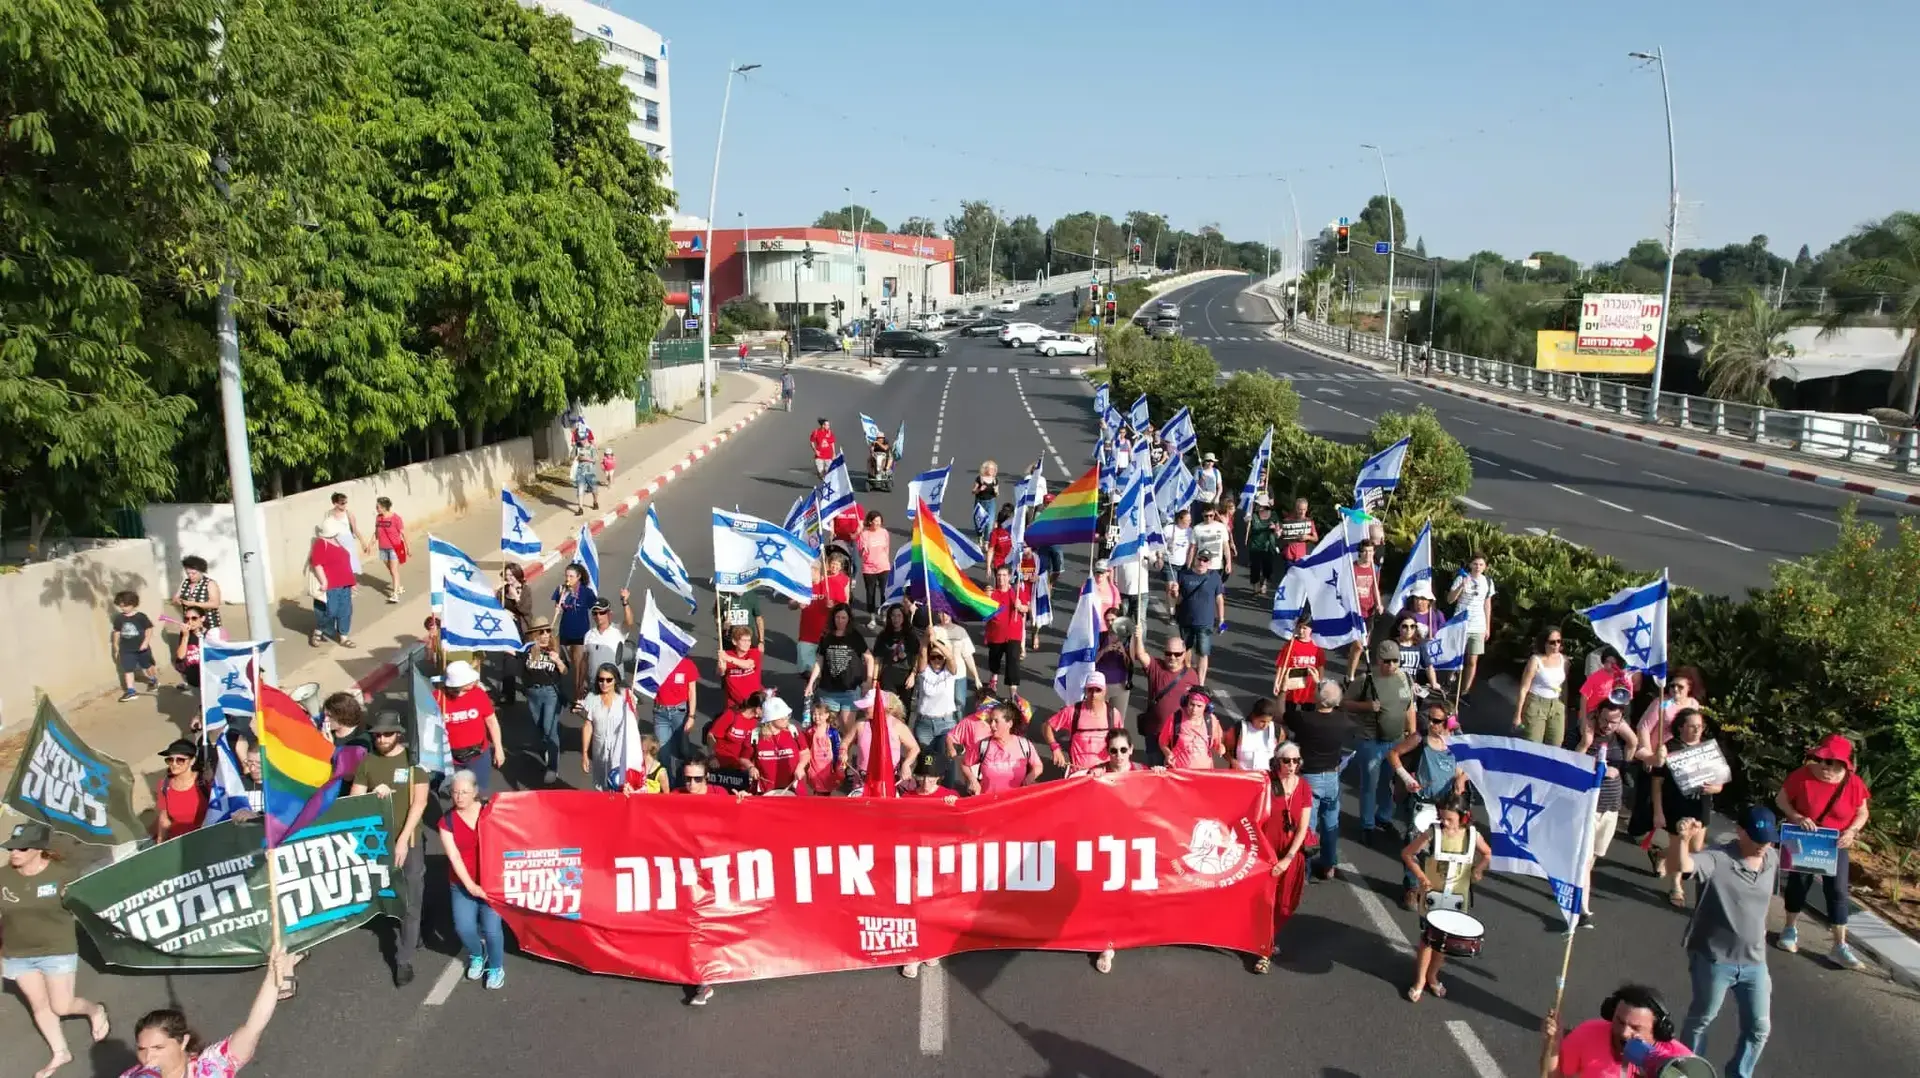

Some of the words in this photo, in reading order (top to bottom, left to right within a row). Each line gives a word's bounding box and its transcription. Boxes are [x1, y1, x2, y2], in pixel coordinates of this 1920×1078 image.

[206, 855, 256, 880] אחוות
[273, 832, 366, 885] אחים
[504, 868, 563, 893] אחים
[614, 848, 776, 912] מדינה
[793, 844, 876, 904] אין
[894, 839, 1056, 905] שוויון
[1076, 835, 1159, 892] בלי
[275, 858, 391, 928] לנשק
[210, 909, 269, 937] להצלת
[856, 915, 917, 932] חופשי
[860, 930, 919, 951] בארצנו
